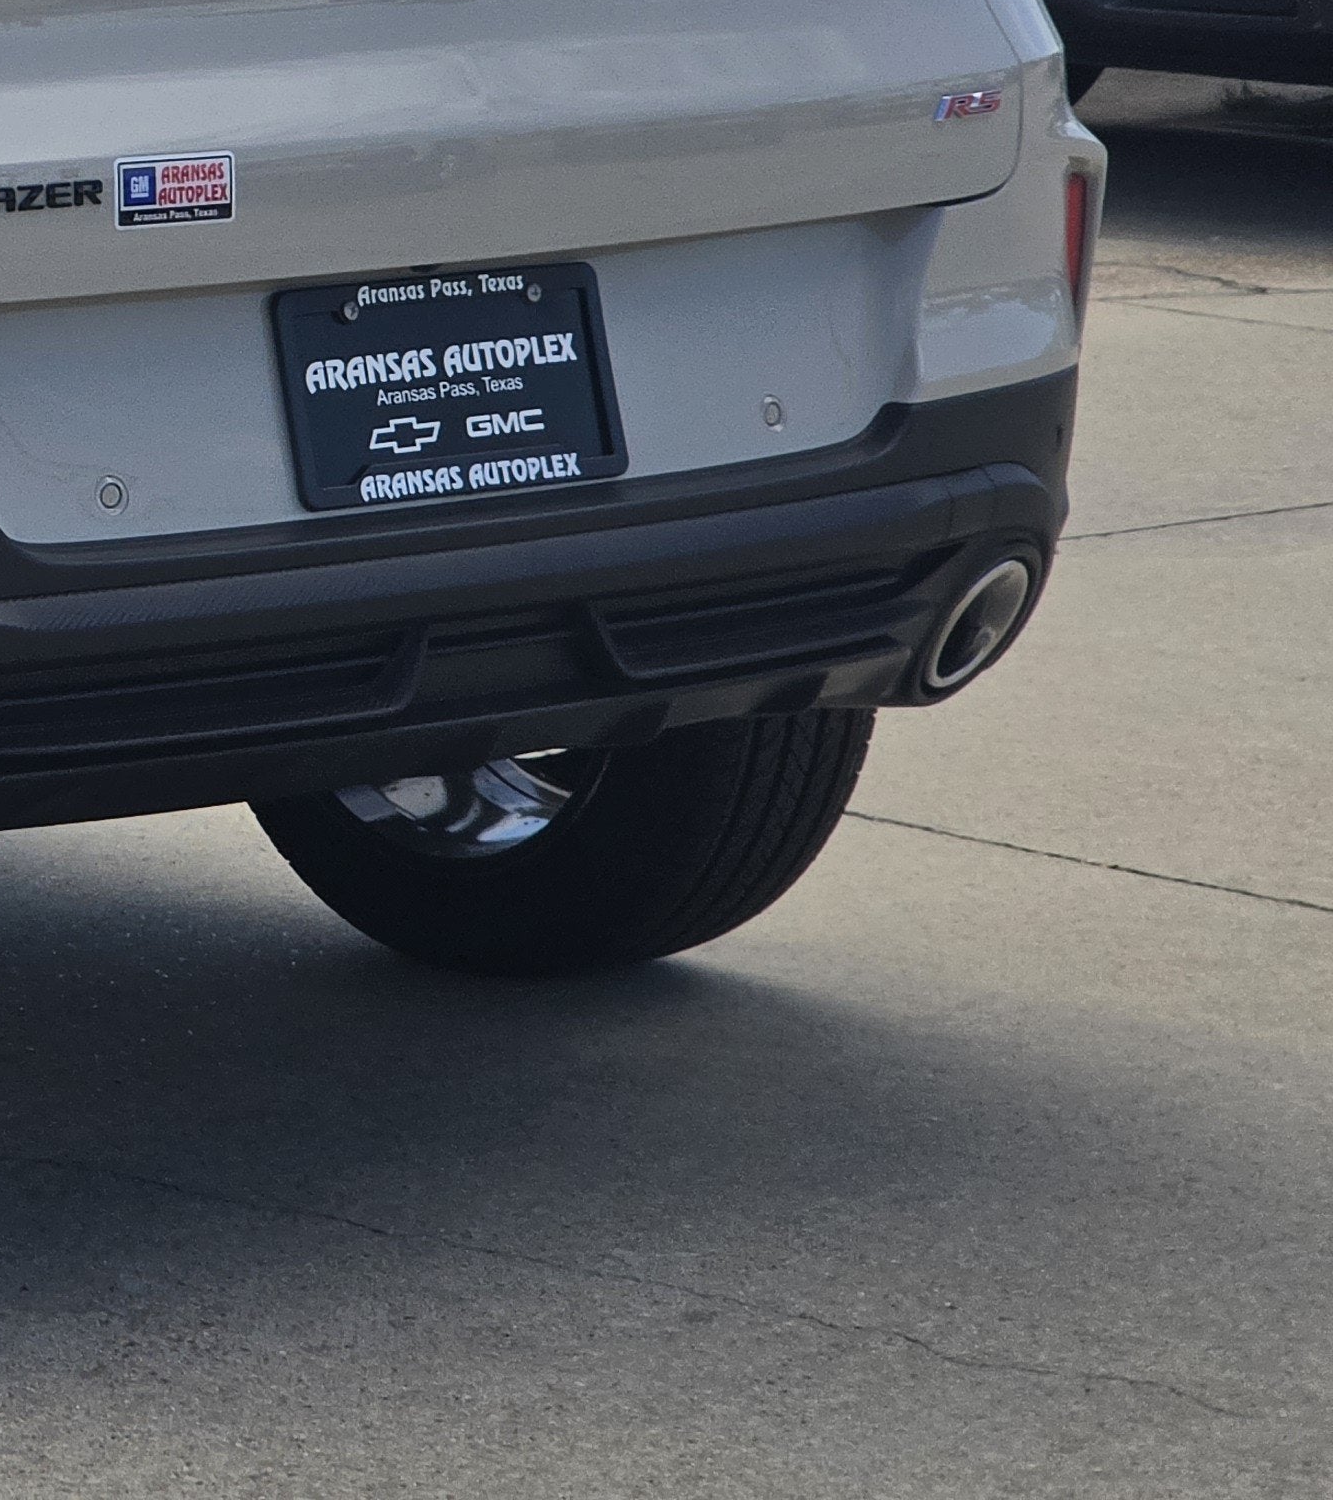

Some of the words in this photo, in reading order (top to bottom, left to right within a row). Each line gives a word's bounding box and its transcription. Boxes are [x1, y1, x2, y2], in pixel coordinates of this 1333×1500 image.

[933, 90, 1001, 121] RS
[130, 175, 149, 195] GM
[161, 162, 224, 184] ARANSAS
[158, 183, 228, 206] AUTOPLEX
[357, 285, 424, 306] Aransas
[431, 278, 472, 297] Pass,
[478, 273, 524, 293] Texas
[305, 348, 435, 394] ARANSAS
[443, 332, 577, 378] AUTOPLEX
[377, 385, 436, 406] Aransas
[439, 379, 479, 397] Pass,
[482, 374, 523, 393] Texas
[466, 408, 544, 438] GMC
[359, 465, 463, 501] ARANSAS
[468, 452, 581, 488] AUTOPLEX
